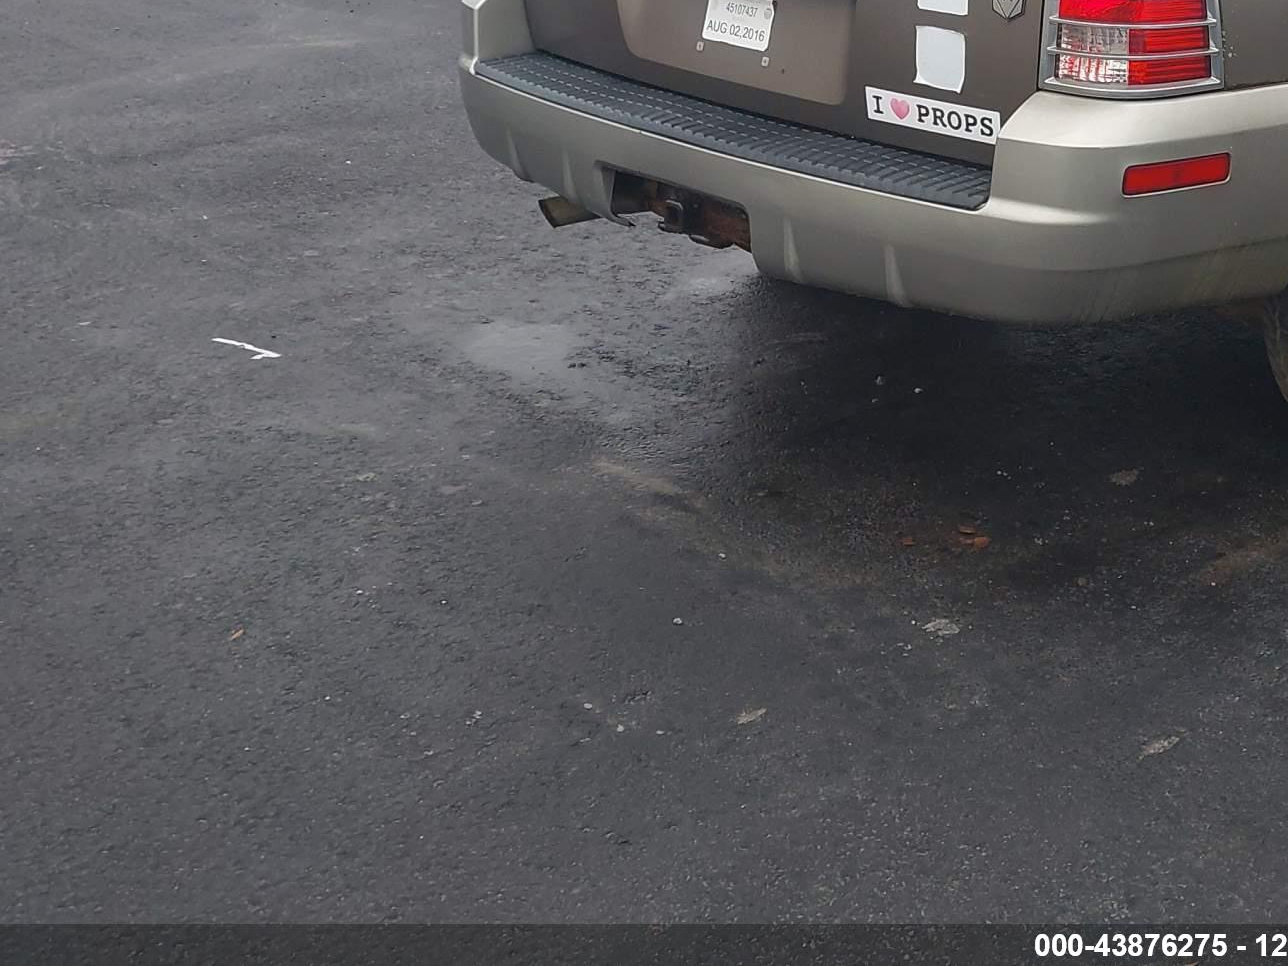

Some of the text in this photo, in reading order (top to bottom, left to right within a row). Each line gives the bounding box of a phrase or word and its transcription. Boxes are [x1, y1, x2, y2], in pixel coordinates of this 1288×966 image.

[725, 1, 758, 17] 45107437
[706, 19, 765, 42] AUG 02,2016
[872, 95, 994, 138] I PROPS
